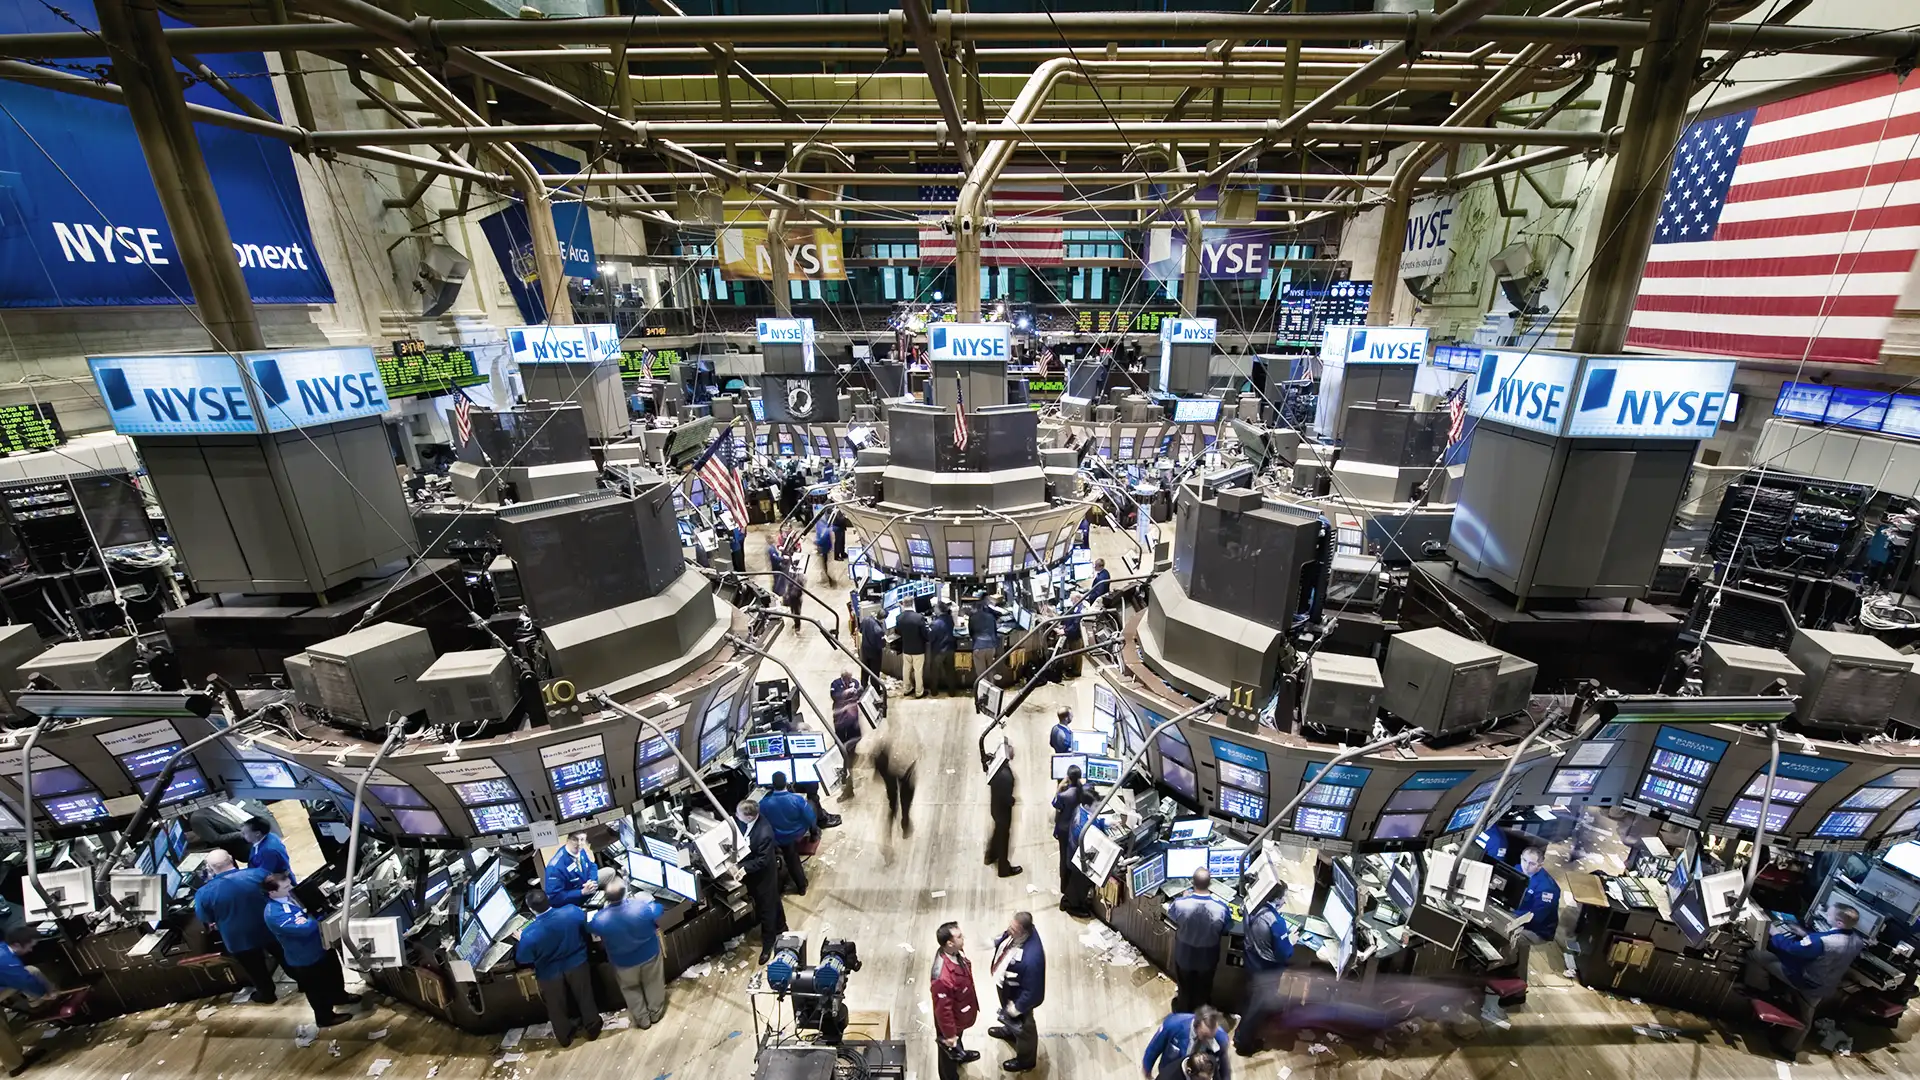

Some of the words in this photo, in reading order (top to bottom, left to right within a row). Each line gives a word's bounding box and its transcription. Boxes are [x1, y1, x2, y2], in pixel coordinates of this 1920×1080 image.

[1402, 209, 1453, 252] NYSE
[52, 222, 169, 264] NYSE
[231, 242, 309, 271] onext
[569, 244, 590, 263] Arca
[755, 244, 840, 274] NYSE
[1289, 289, 1304, 297] NYSE
[771, 328, 801, 339] NYSE
[1184, 328, 1214, 339] NYSE
[532, 340, 586, 359] NYSE
[600, 339, 620, 356] NYSE
[953, 338, 1004, 356] NYSE
[1370, 342, 1422, 359] NYSE
[142, 386, 252, 422] NYSE
[296, 371, 383, 416] NYSE
[1493, 377, 1564, 425] NYSE
[1616, 390, 1724, 426] NYSE
[541, 680, 576, 706] 10
[1233, 686, 1253, 710] 11
[104, 738, 127, 746] Bank
[137, 727, 173, 738] America
